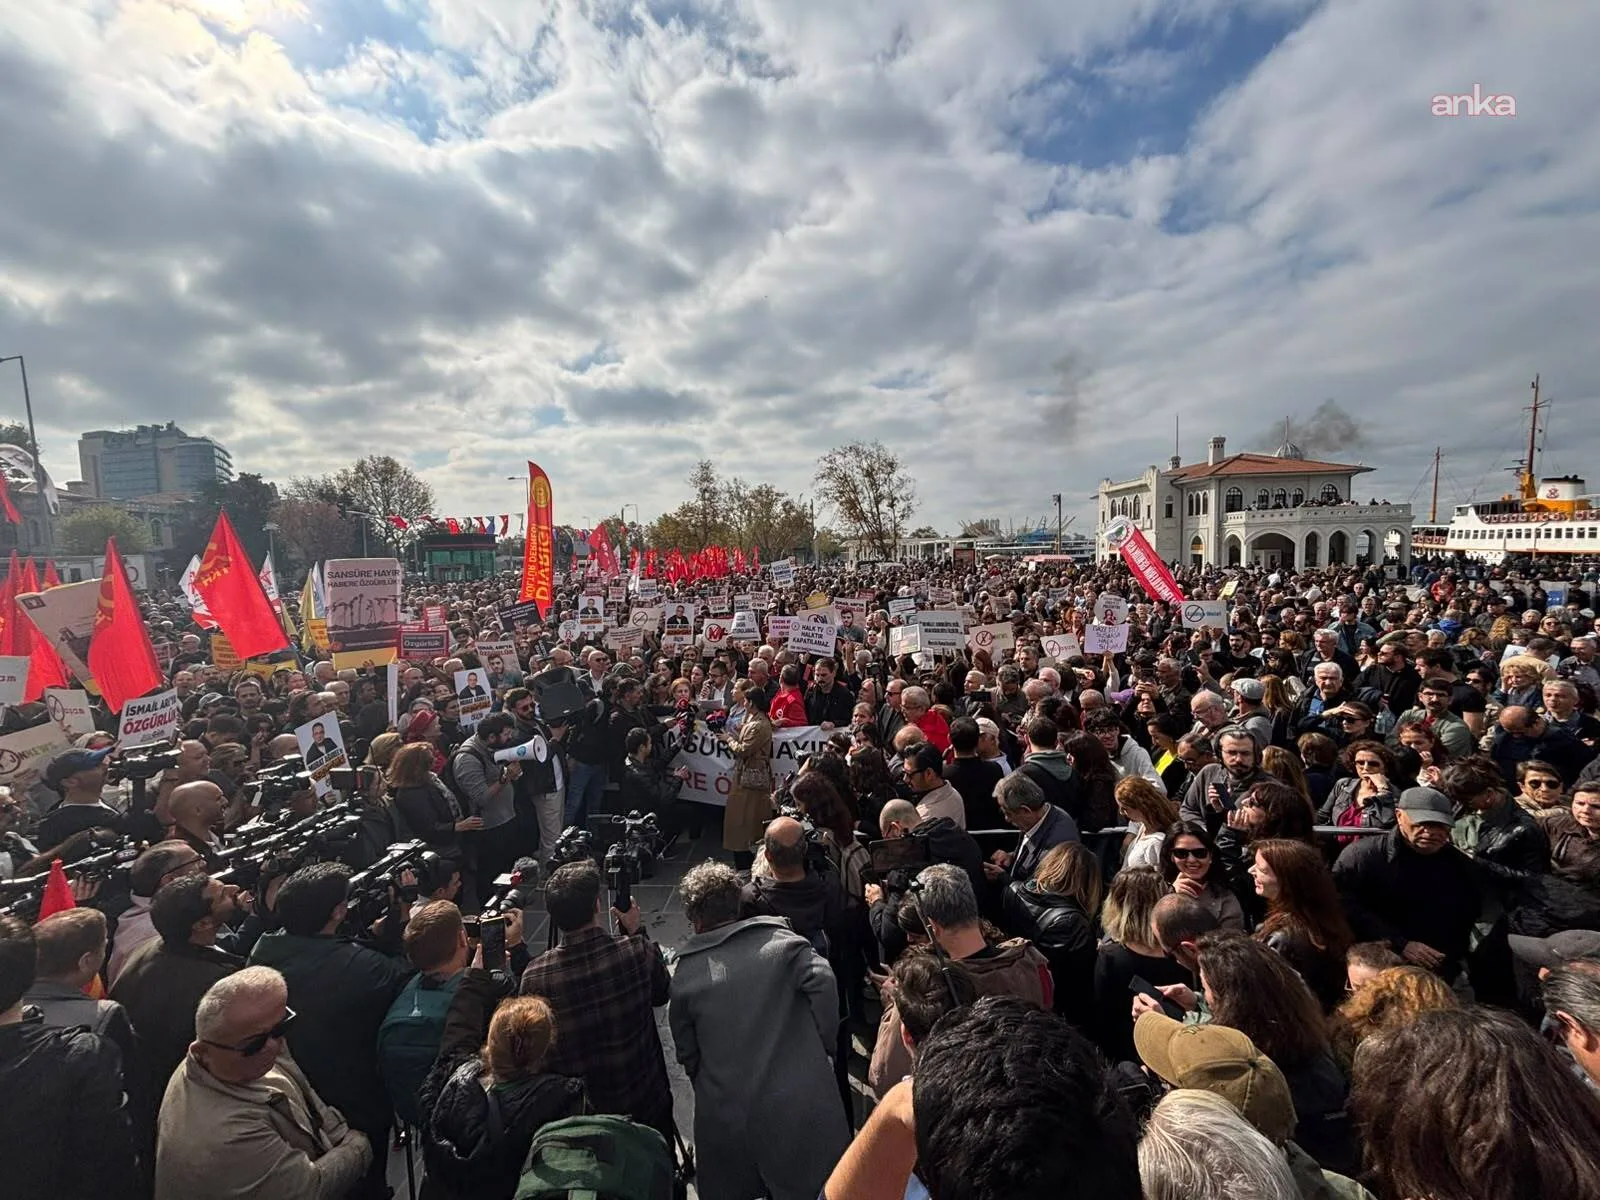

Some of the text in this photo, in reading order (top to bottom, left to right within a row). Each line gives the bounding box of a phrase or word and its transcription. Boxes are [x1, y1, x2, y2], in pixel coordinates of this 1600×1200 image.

[327, 568, 400, 579] SANSÜRE HAYIR
[801, 624, 815, 632] HALK
[801, 631, 824, 640] HALKTIR
[125, 701, 158, 717] İSMAİL
